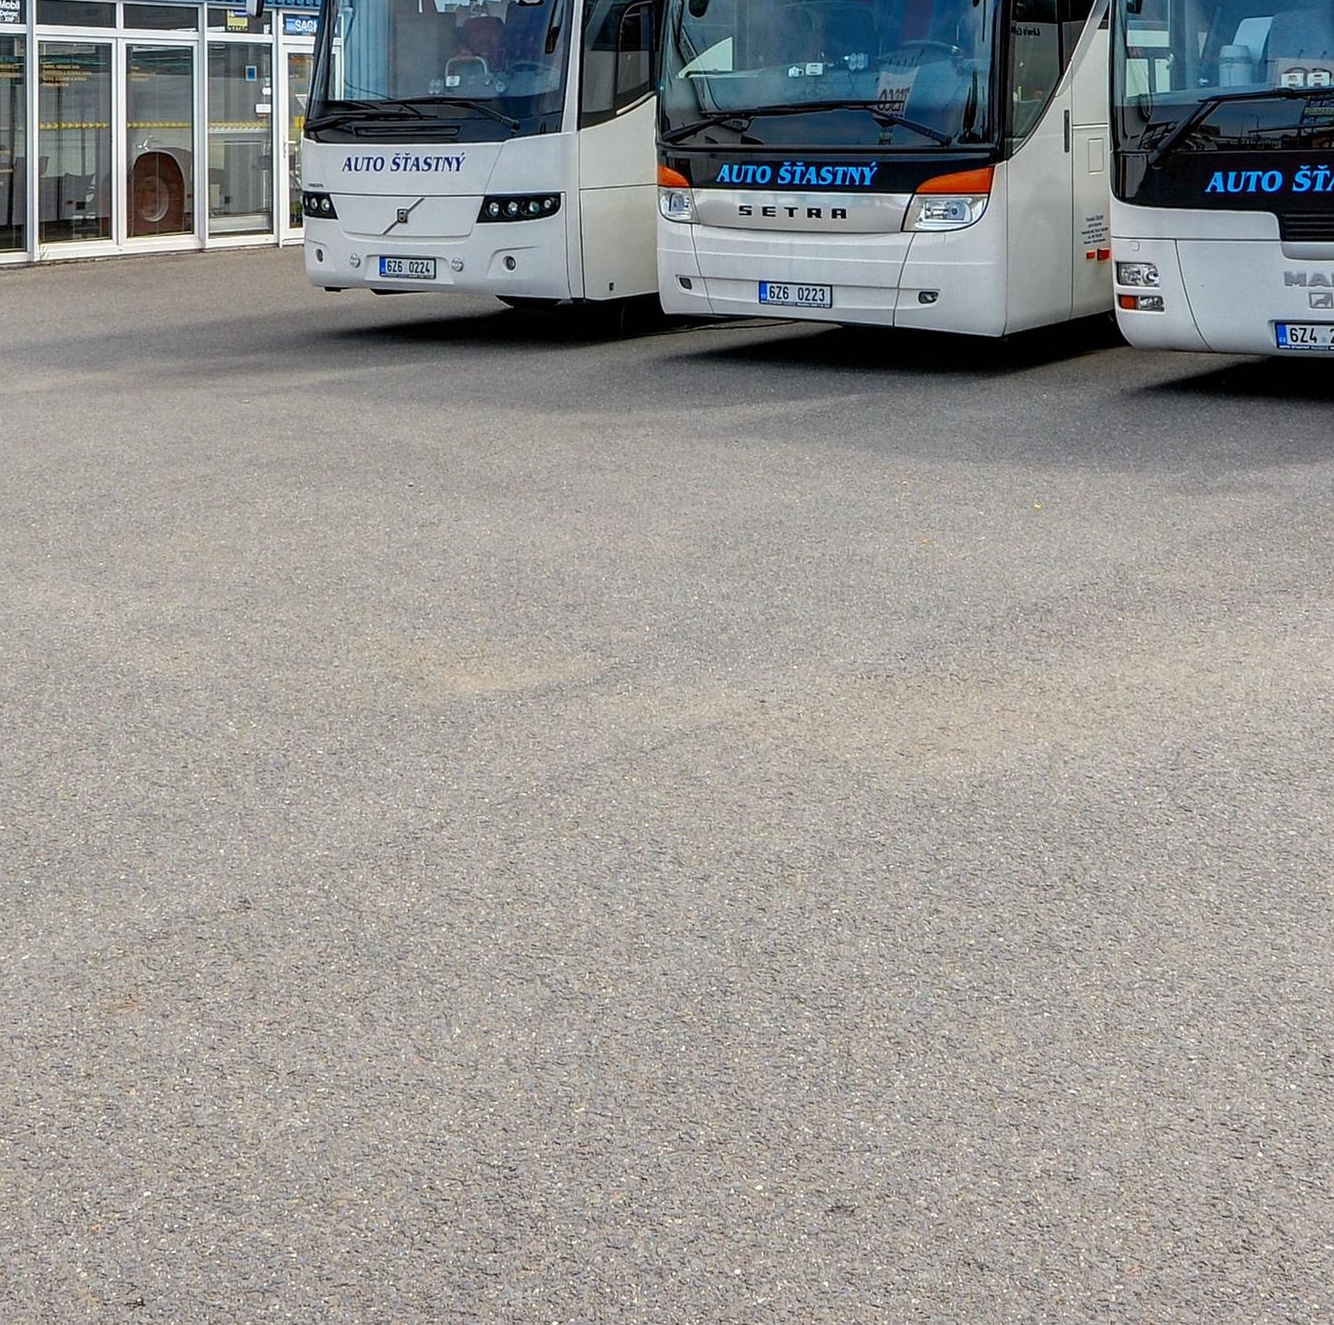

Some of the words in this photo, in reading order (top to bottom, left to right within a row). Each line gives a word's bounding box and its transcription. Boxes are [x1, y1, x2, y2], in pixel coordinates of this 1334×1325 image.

[342, 157, 385, 172] AUTO
[390, 152, 466, 172] ŠŤASTNÝ
[716, 164, 772, 184] AUTO
[777, 161, 879, 186] ŠŤASTNÝ
[1205, 170, 1283, 193] AUTO
[738, 205, 847, 220] SETRA
[387, 260, 403, 273] 6Z6
[409, 261, 430, 274] 0224
[769, 285, 789, 300] 6Z6
[798, 287, 825, 302] 0223
[1290, 327, 1318, 343] 6Z4
